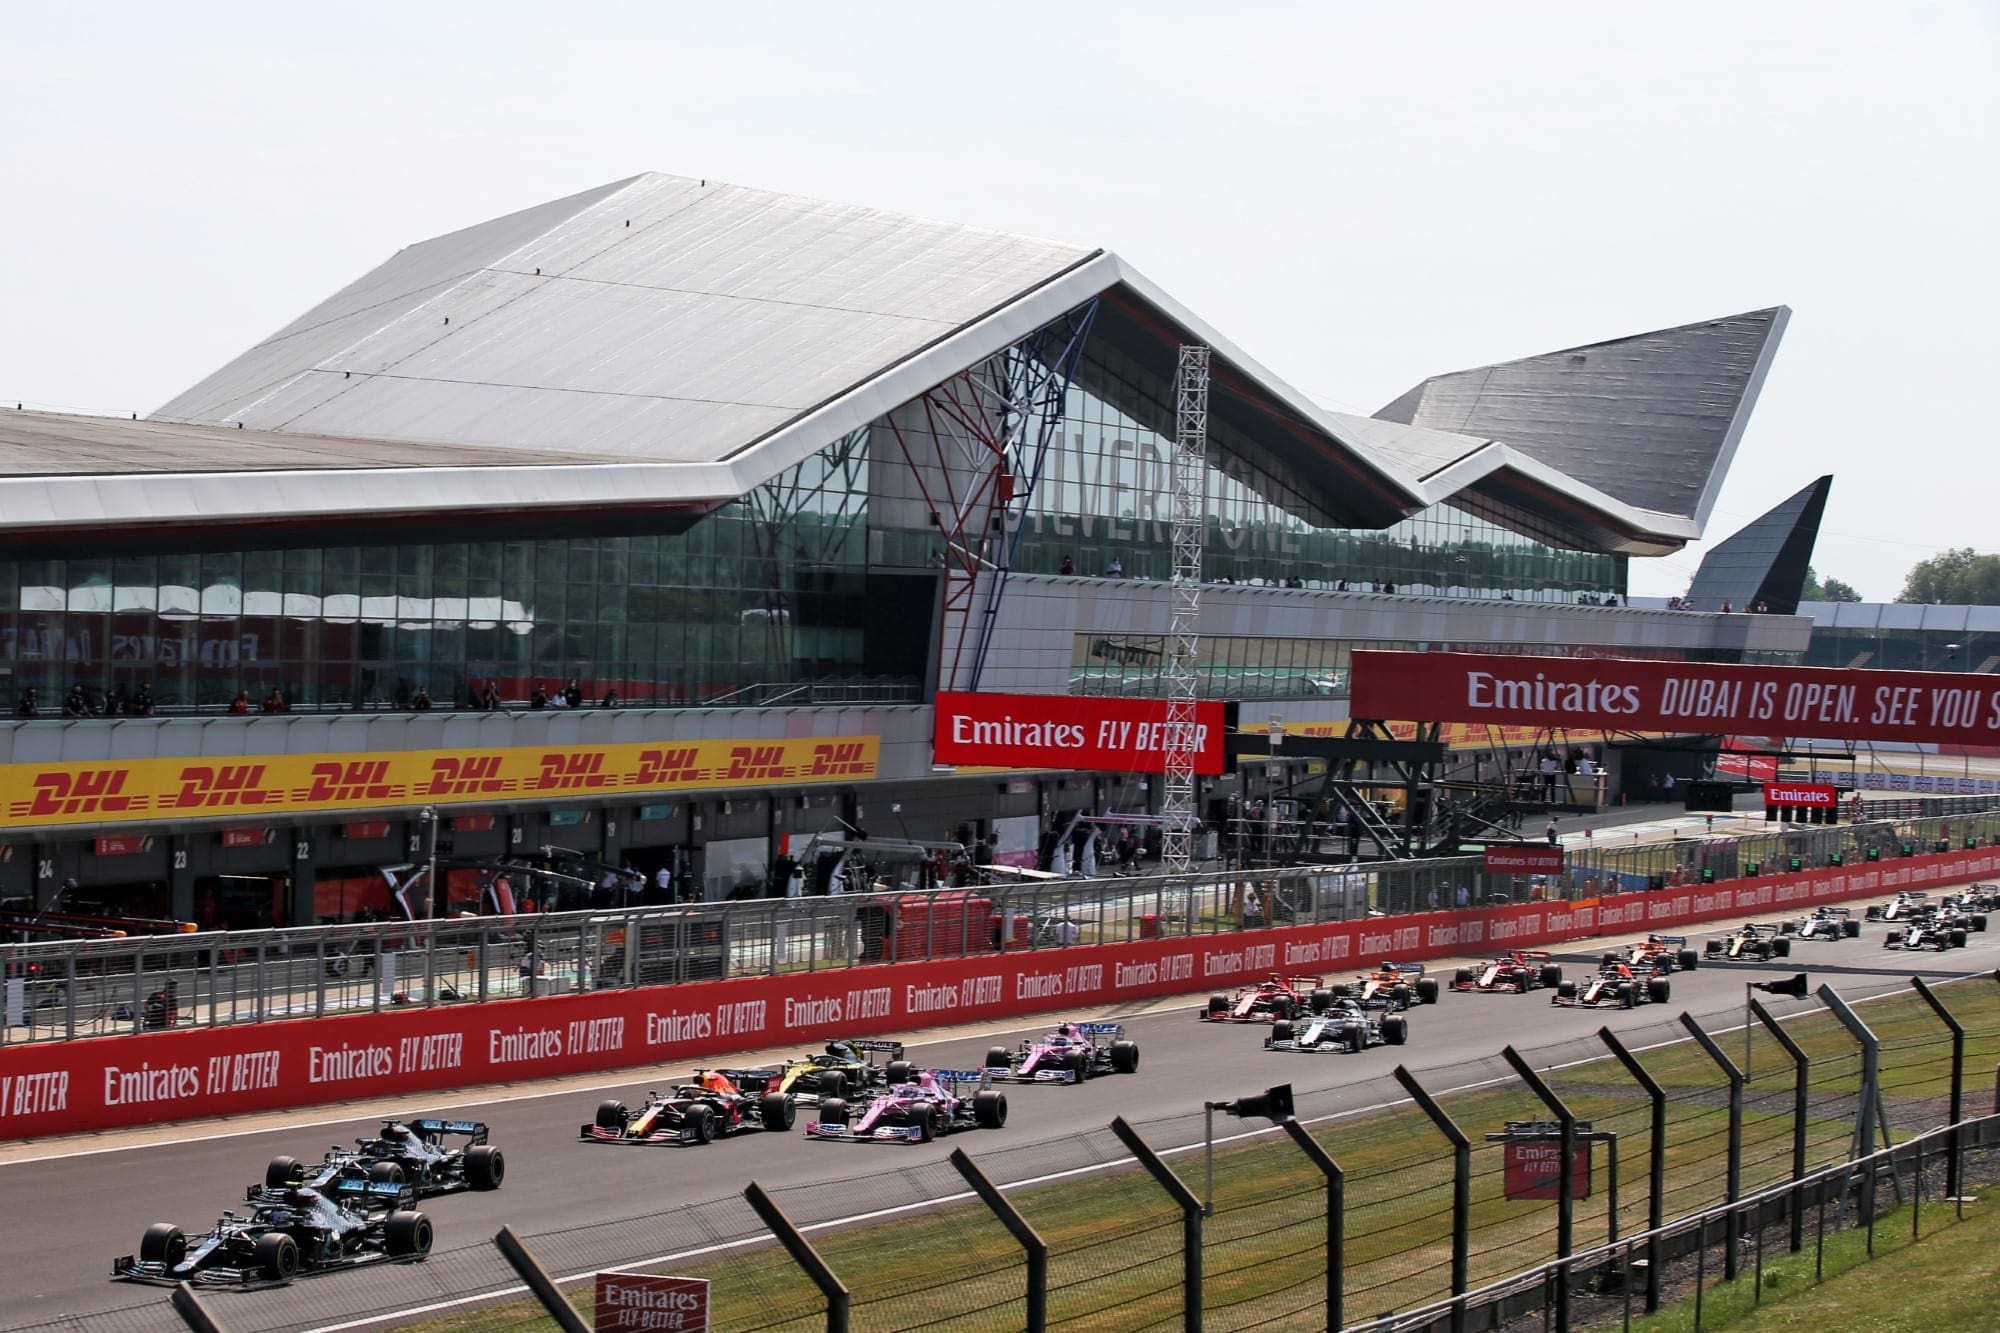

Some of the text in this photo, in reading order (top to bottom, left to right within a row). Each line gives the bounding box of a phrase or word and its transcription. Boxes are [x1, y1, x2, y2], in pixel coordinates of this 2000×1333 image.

[1467, 671, 1640, 714] Emirates
[1659, 678, 1742, 718] DUBAI
[1748, 681, 1777, 720] IS
[1784, 682, 1859, 723] OPEN.
[1871, 686, 1922, 726] SEE
[1929, 688, 1980, 728] YOU
[951, 715, 1085, 748] Emirates
[1097, 720, 1132, 750] FLY
[428, 757, 503, 795] DHL
[536, 753, 606, 790] DHL
[636, 748, 700, 785] DHL
[727, 746, 785, 780] DHL
[811, 743, 864, 776] DHL
[29, 770, 131, 816] DHL
[175, 765, 267, 808] DHL
[307, 761, 391, 801] DHL
[1769, 788, 1830, 802] Emirates
[174, 851, 187, 869] 23
[297, 842, 309, 859] 22
[410, 835, 420, 851] 21
[39, 859, 53, 879] 24
[1115, 960, 1157, 988] Emirates
[1204, 949, 1242, 976] Emirates
[906, 975, 1002, 1013] Emirates FLY BETTER
[1016, 964, 1102, 999] Emirates FLY BETTER
[647, 1000, 766, 1045] Emirates FLY BETTER
[784, 987, 891, 1028] Emirates FLY BETTER
[309, 1032, 463, 1083] Emirates FLY BETTER
[489, 1017, 624, 1064] Emirates FLY BETTER
[13, 1071, 69, 1115] BETTER
[104, 1051, 280, 1105] Emirates FLY BETTER
[1516, 1146, 1577, 1160] Emira
[605, 1284, 698, 1310] Emirates
[619, 1309, 684, 1329] FLY BETTER
